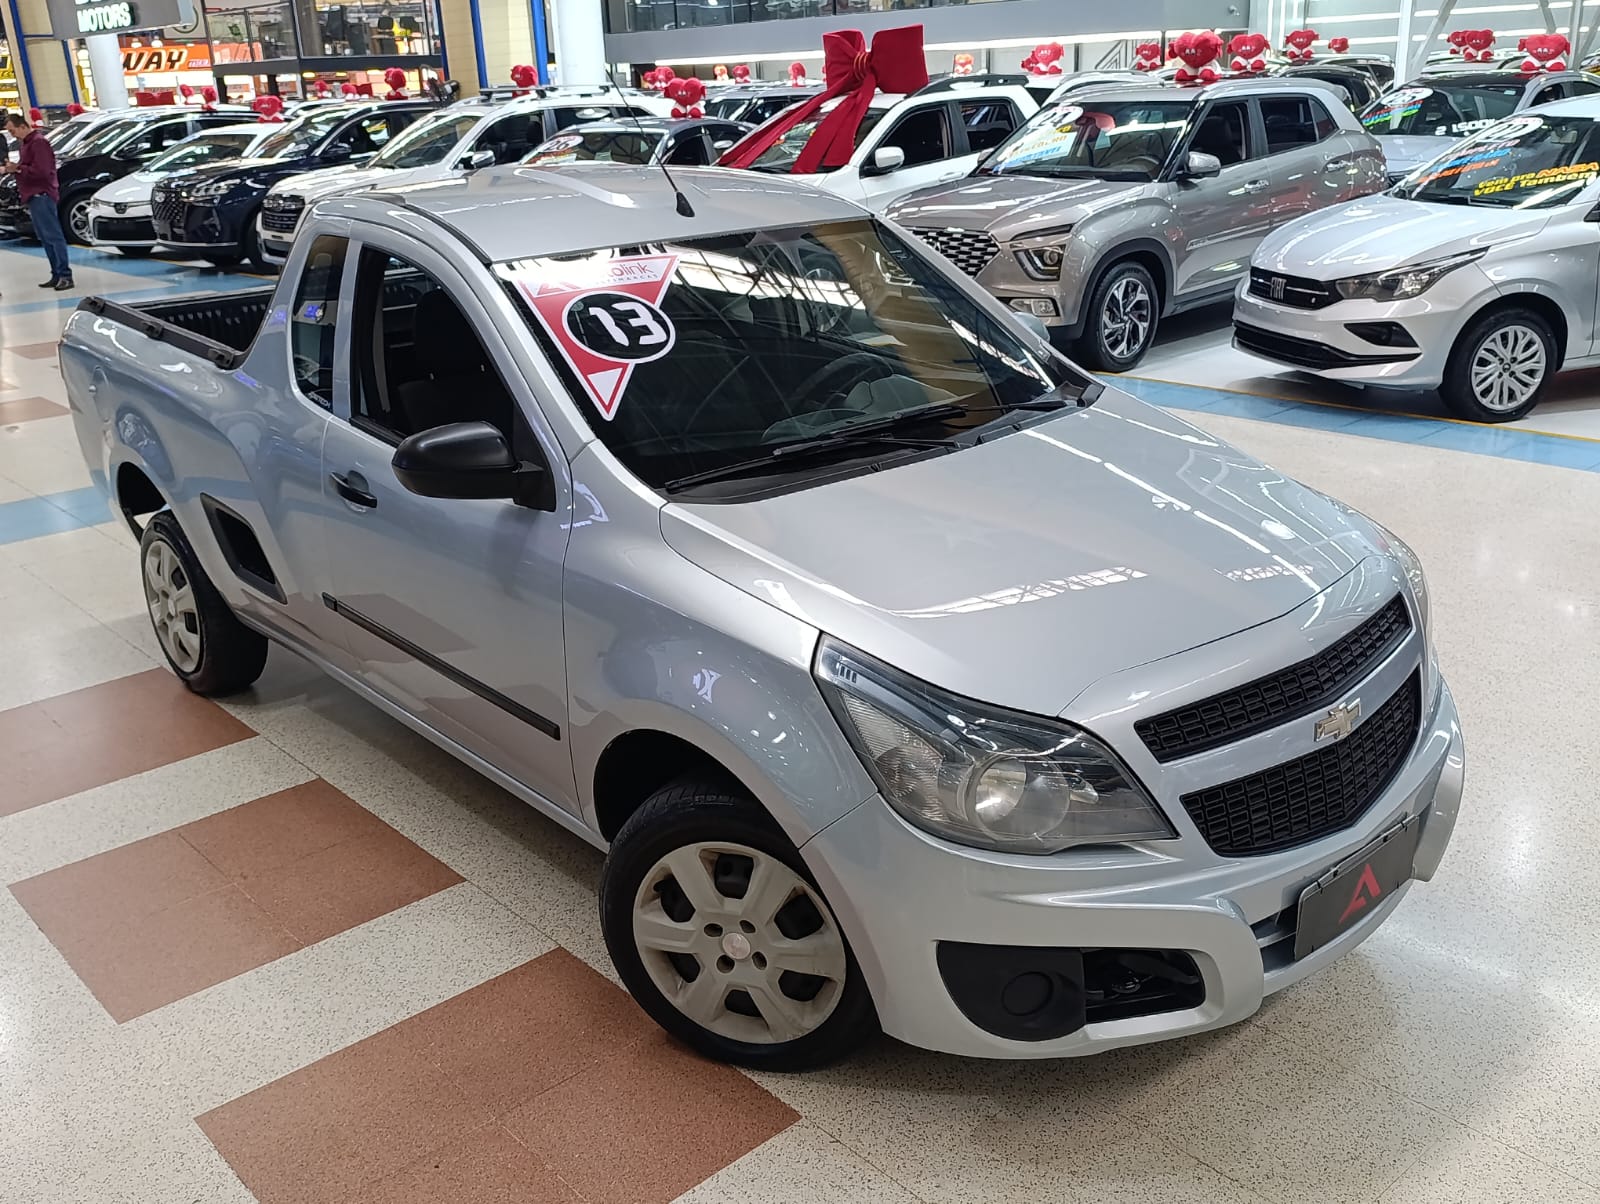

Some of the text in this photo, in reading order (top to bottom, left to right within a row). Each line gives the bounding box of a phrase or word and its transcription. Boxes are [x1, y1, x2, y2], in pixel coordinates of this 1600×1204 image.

[77, 2, 131, 32] MOTORS
[1270, 276, 1287, 300] FIAT
[588, 301, 668, 347] 13
